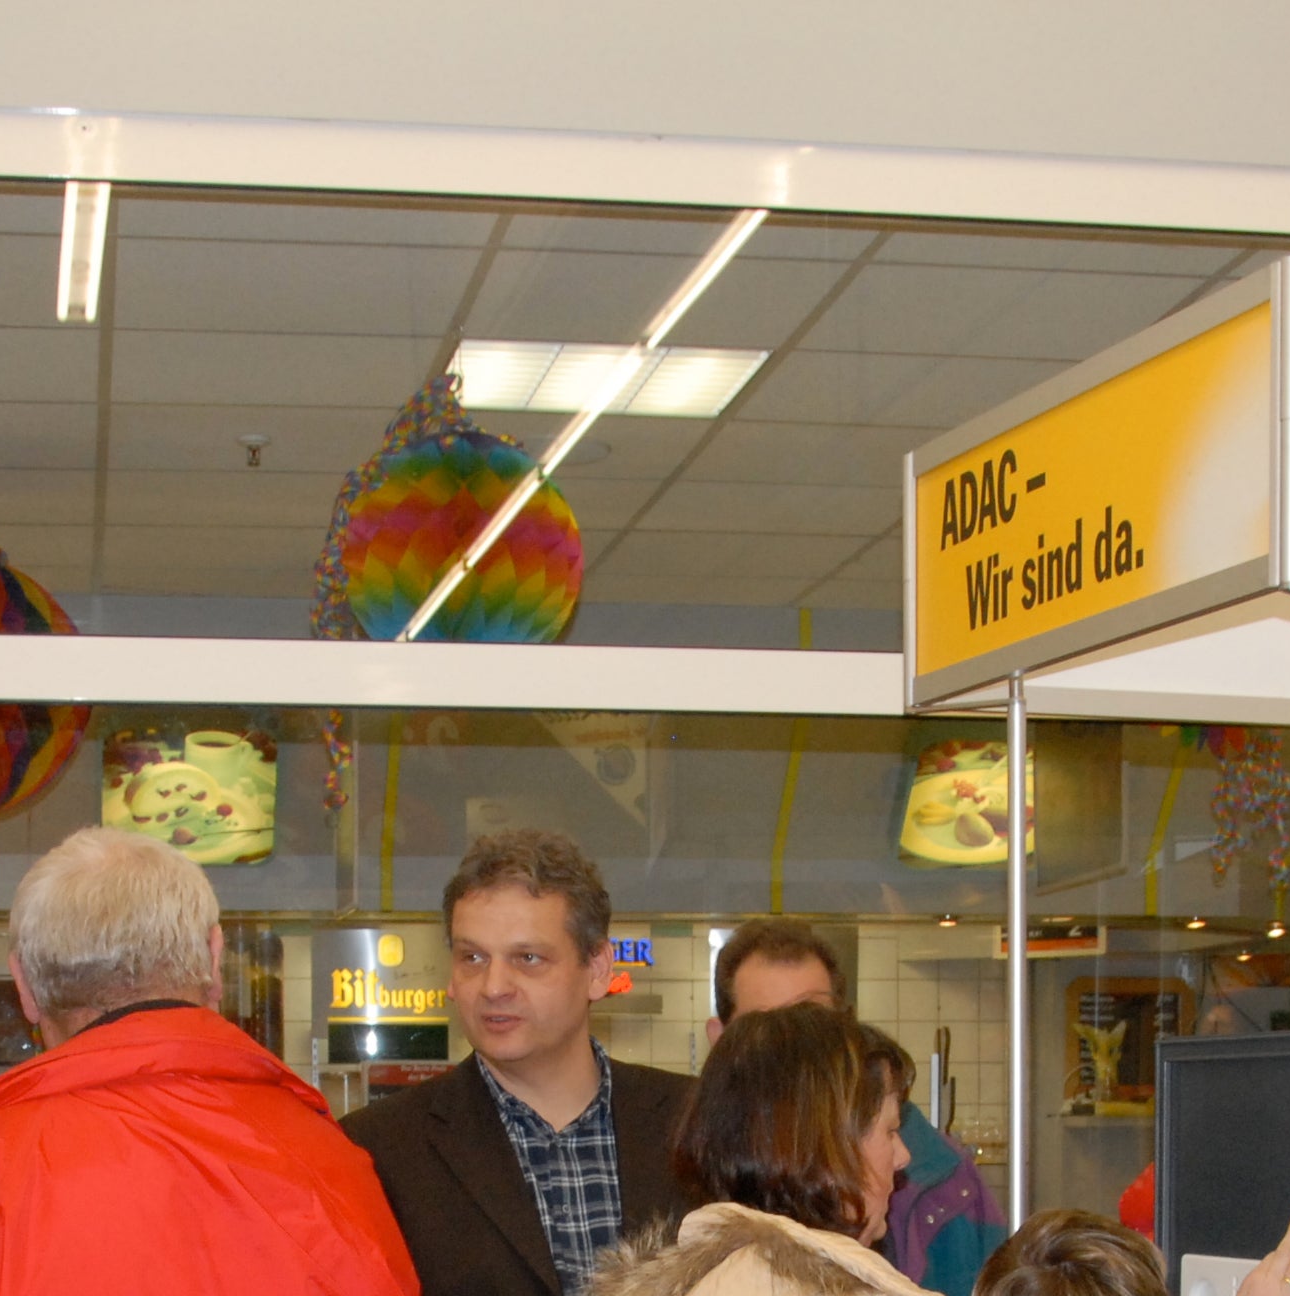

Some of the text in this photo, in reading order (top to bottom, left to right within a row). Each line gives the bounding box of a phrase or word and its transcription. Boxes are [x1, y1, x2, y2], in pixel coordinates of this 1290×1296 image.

[940, 449, 1017, 551] ADAC
[966, 505, 1144, 631] Wir sind da.
[330, 967, 447, 1014] Bitburger
